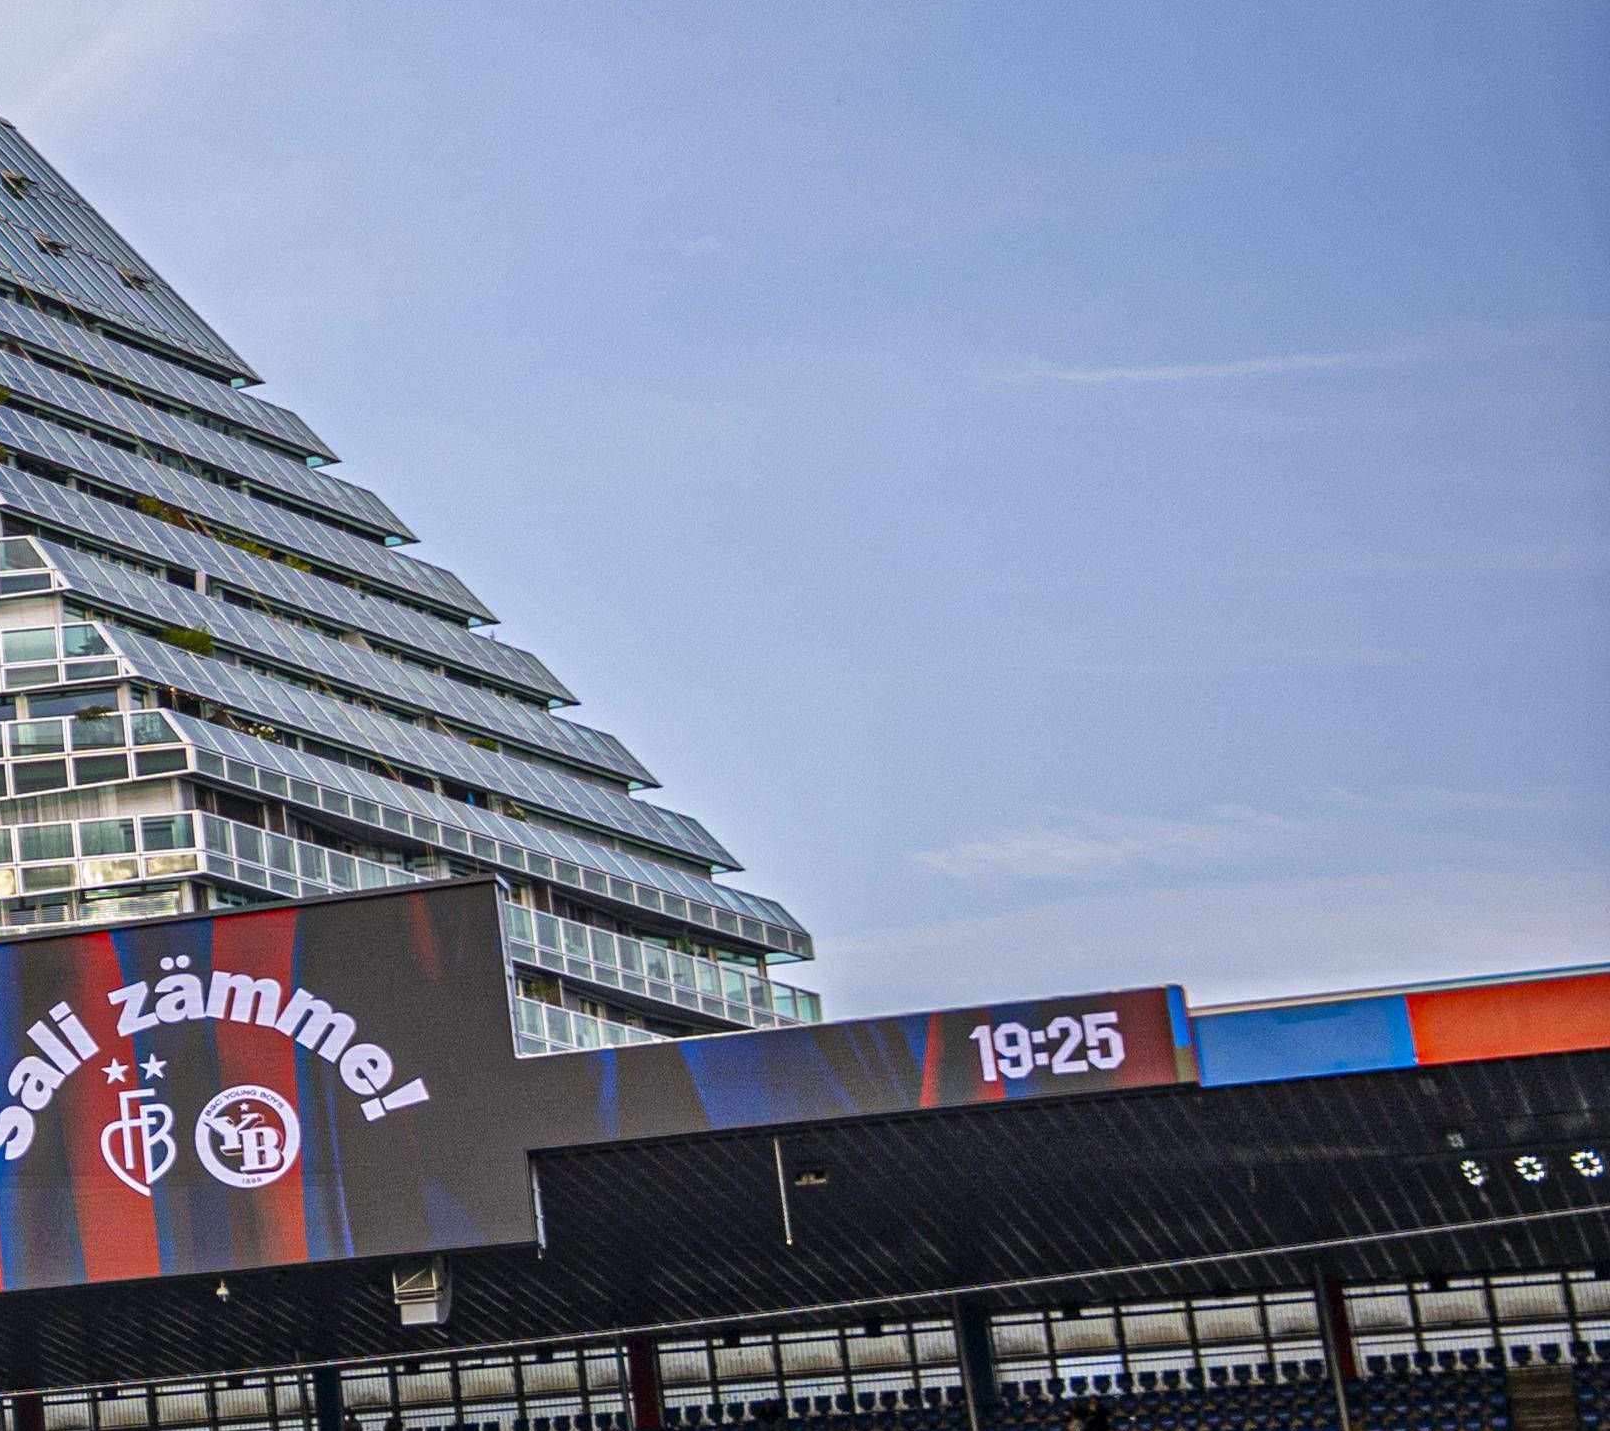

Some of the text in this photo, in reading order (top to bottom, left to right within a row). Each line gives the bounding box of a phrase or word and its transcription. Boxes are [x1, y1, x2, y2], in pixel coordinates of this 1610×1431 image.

[107, 954, 431, 1122] zämme!
[969, 1010, 1126, 1083] 19:25
[223, 1088, 257, 1102] YOUNG
